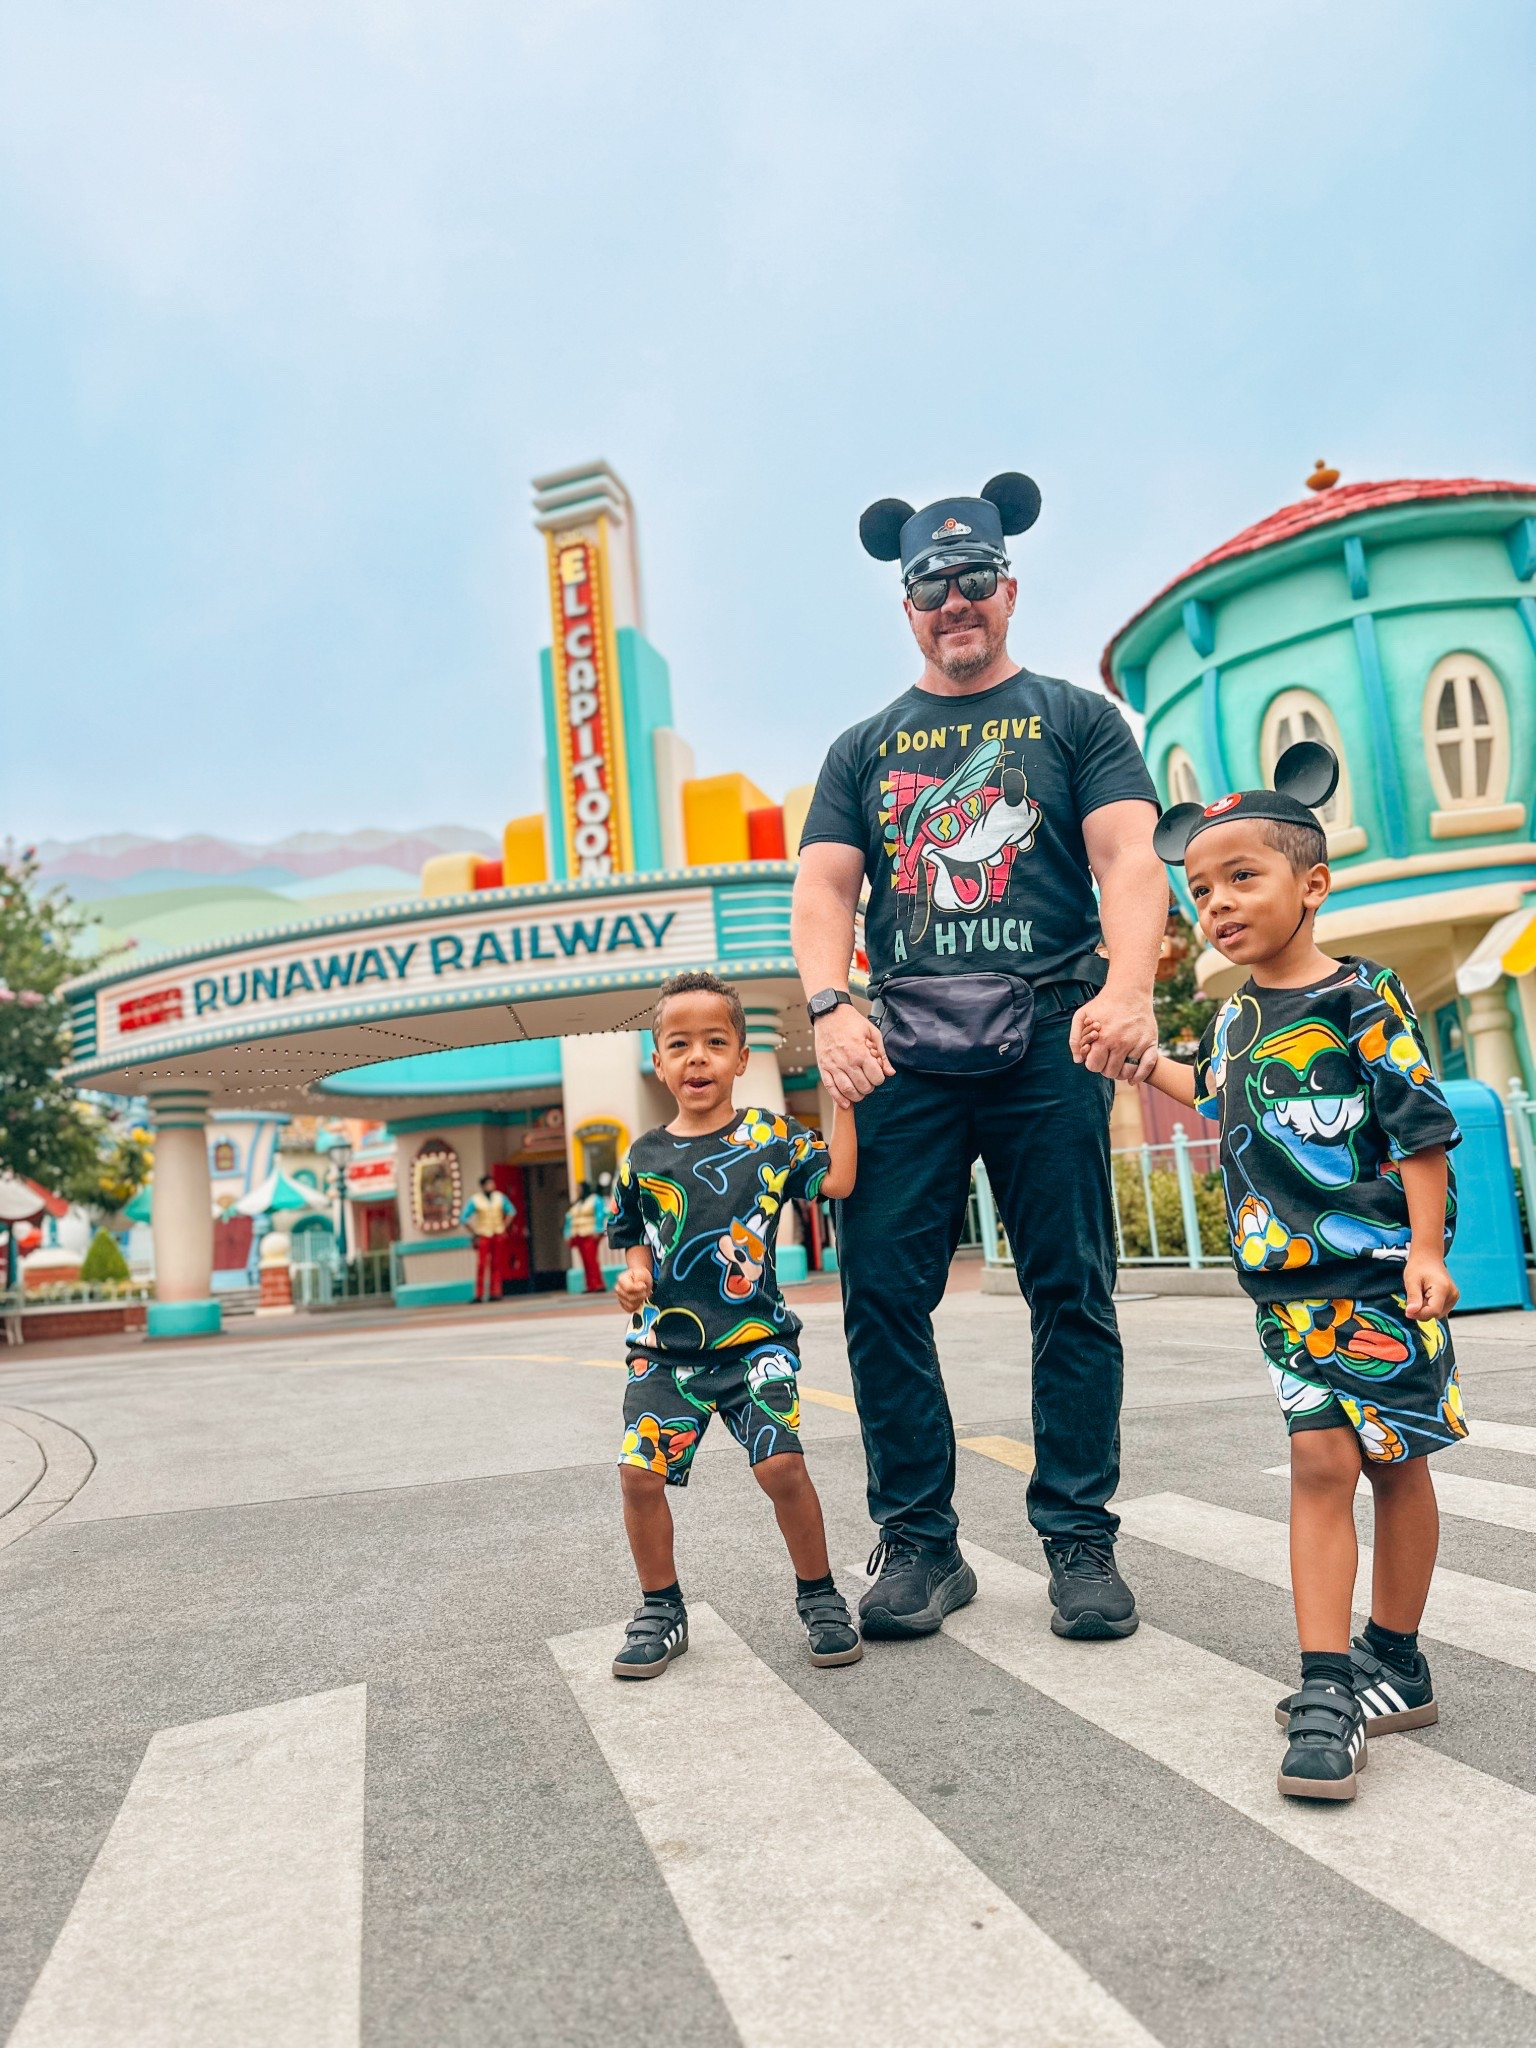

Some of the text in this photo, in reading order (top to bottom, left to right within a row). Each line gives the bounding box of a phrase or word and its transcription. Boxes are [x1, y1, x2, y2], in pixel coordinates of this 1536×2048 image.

[559, 548, 588, 617] EL
[880, 716, 1041, 757] I DON'T GIVE
[193, 911, 677, 1015] RUNAWAY RAILWAY
[895, 917, 1033, 962] A HYUCK
